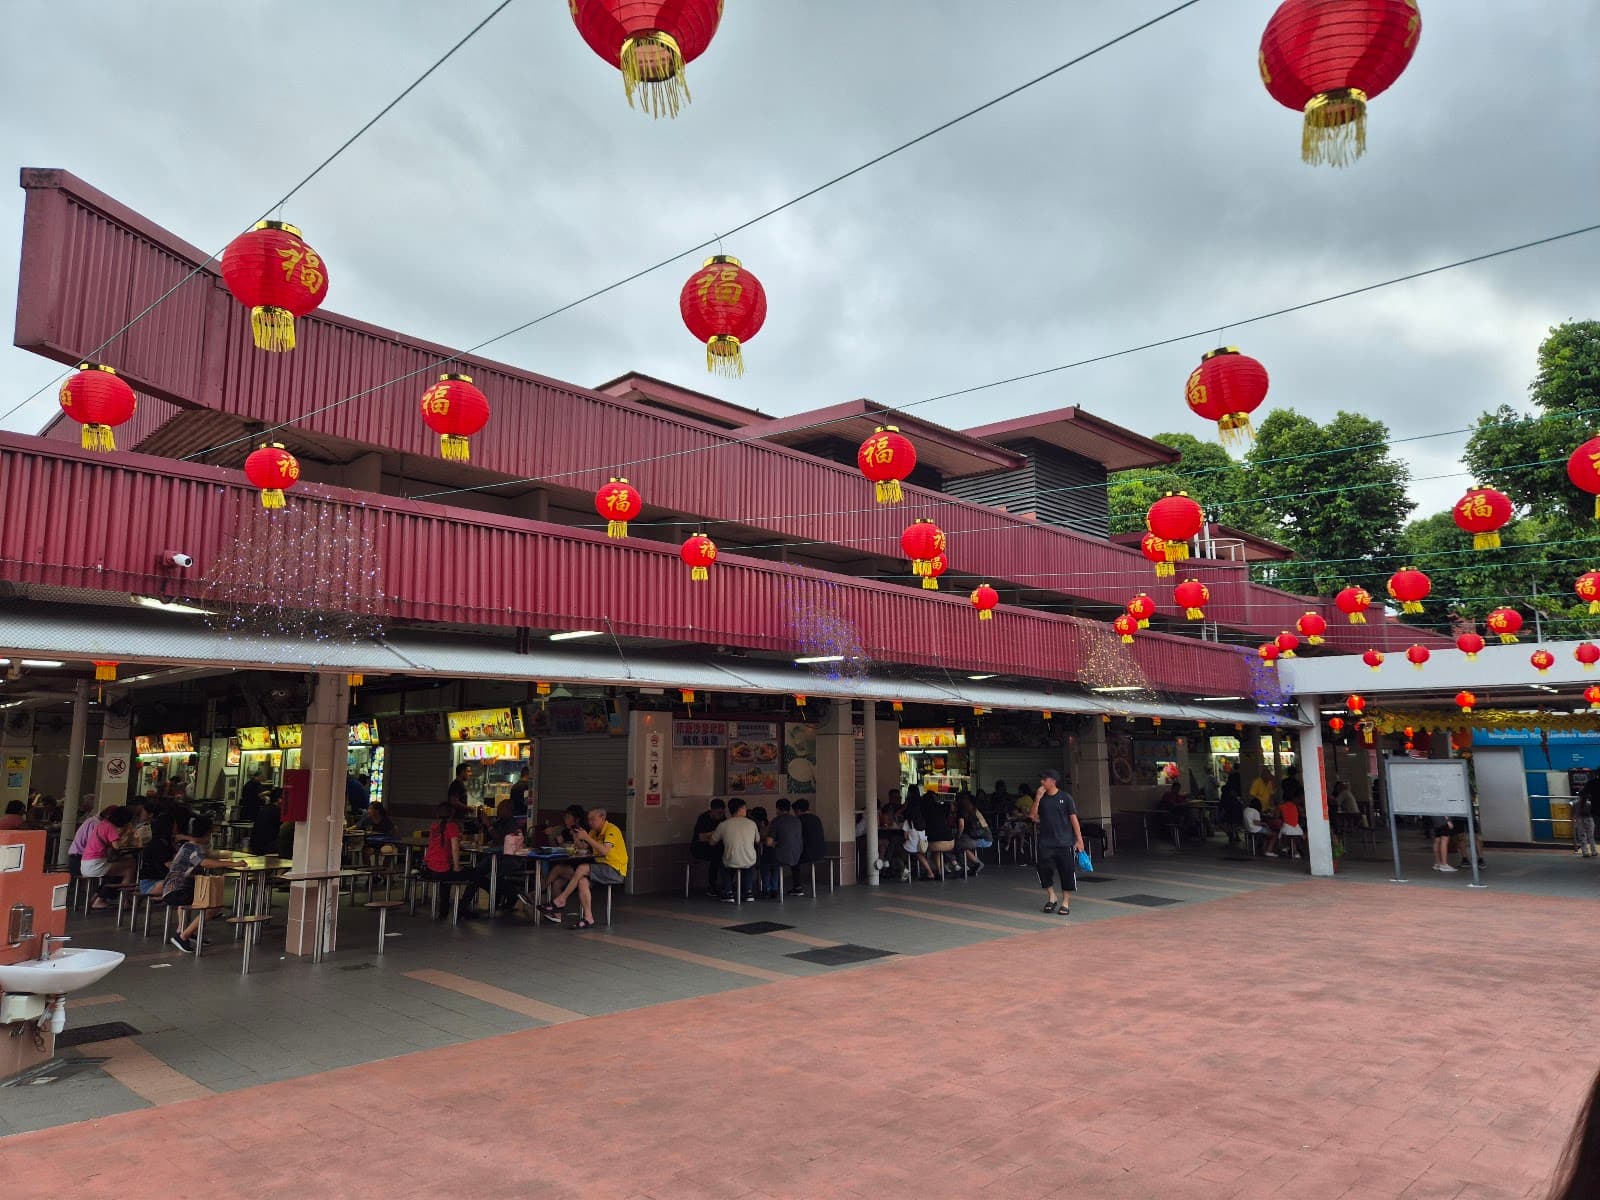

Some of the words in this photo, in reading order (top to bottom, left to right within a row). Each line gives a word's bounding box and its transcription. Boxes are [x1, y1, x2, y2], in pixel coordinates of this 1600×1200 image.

[275, 239, 324, 295] 福
[695, 266, 742, 305] 福
[422, 386, 451, 416] 福
[864, 436, 893, 467] 福
[276, 454, 299, 480] 福
[606, 489, 630, 512] 福
[1459, 495, 1493, 520] 福
[700, 541, 716, 559] 福
[1576, 577, 1596, 595] 福
[1128, 600, 1143, 614] 福
[1114, 618, 1129, 631] 福
[1489, 613, 1507, 628] 福
[1533, 653, 1547, 665] 福
